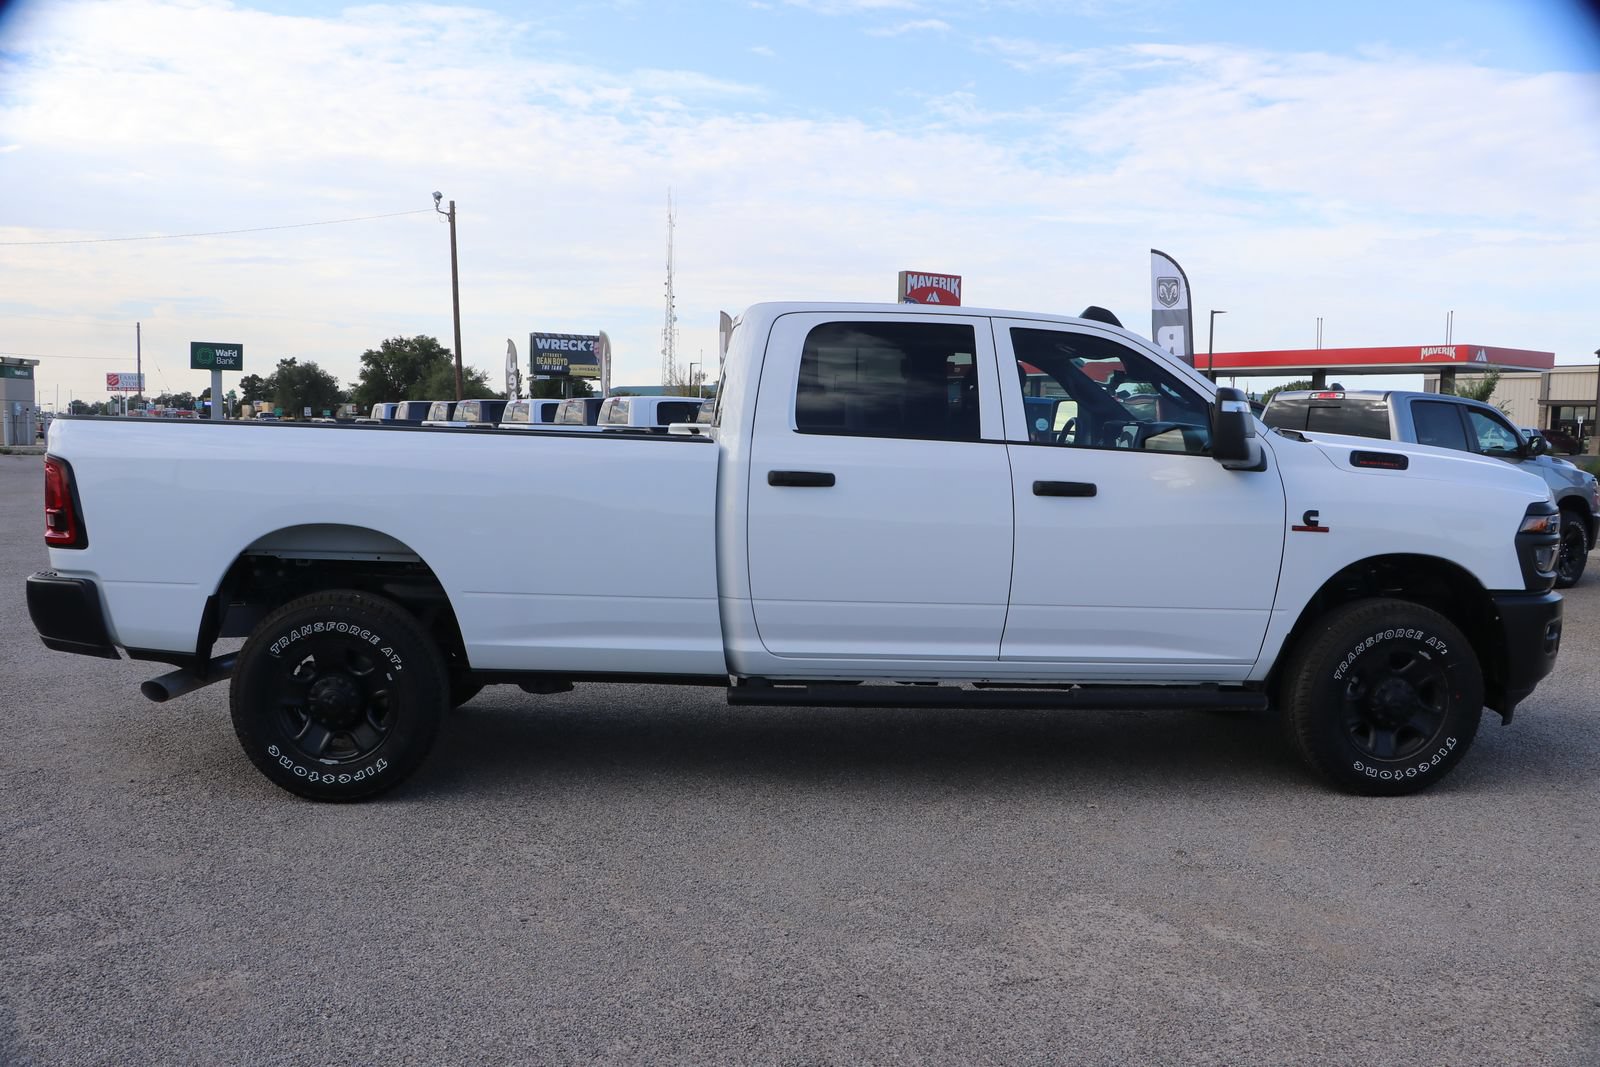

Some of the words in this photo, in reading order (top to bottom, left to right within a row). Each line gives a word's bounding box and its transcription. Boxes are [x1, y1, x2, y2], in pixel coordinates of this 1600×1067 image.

[906, 273, 961, 300] MAVERIK
[535, 338, 594, 352] WRECK?
[215, 349, 238, 358] WaFd
[1420, 346, 1456, 361] MAVERIK
[216, 357, 235, 365] Bank
[536, 357, 553, 365] DEAN
[553, 358, 568, 366] BOYD
[269, 621, 381, 656] TRANSFORCE
[1333, 628, 1424, 681] TRANSFORCE
